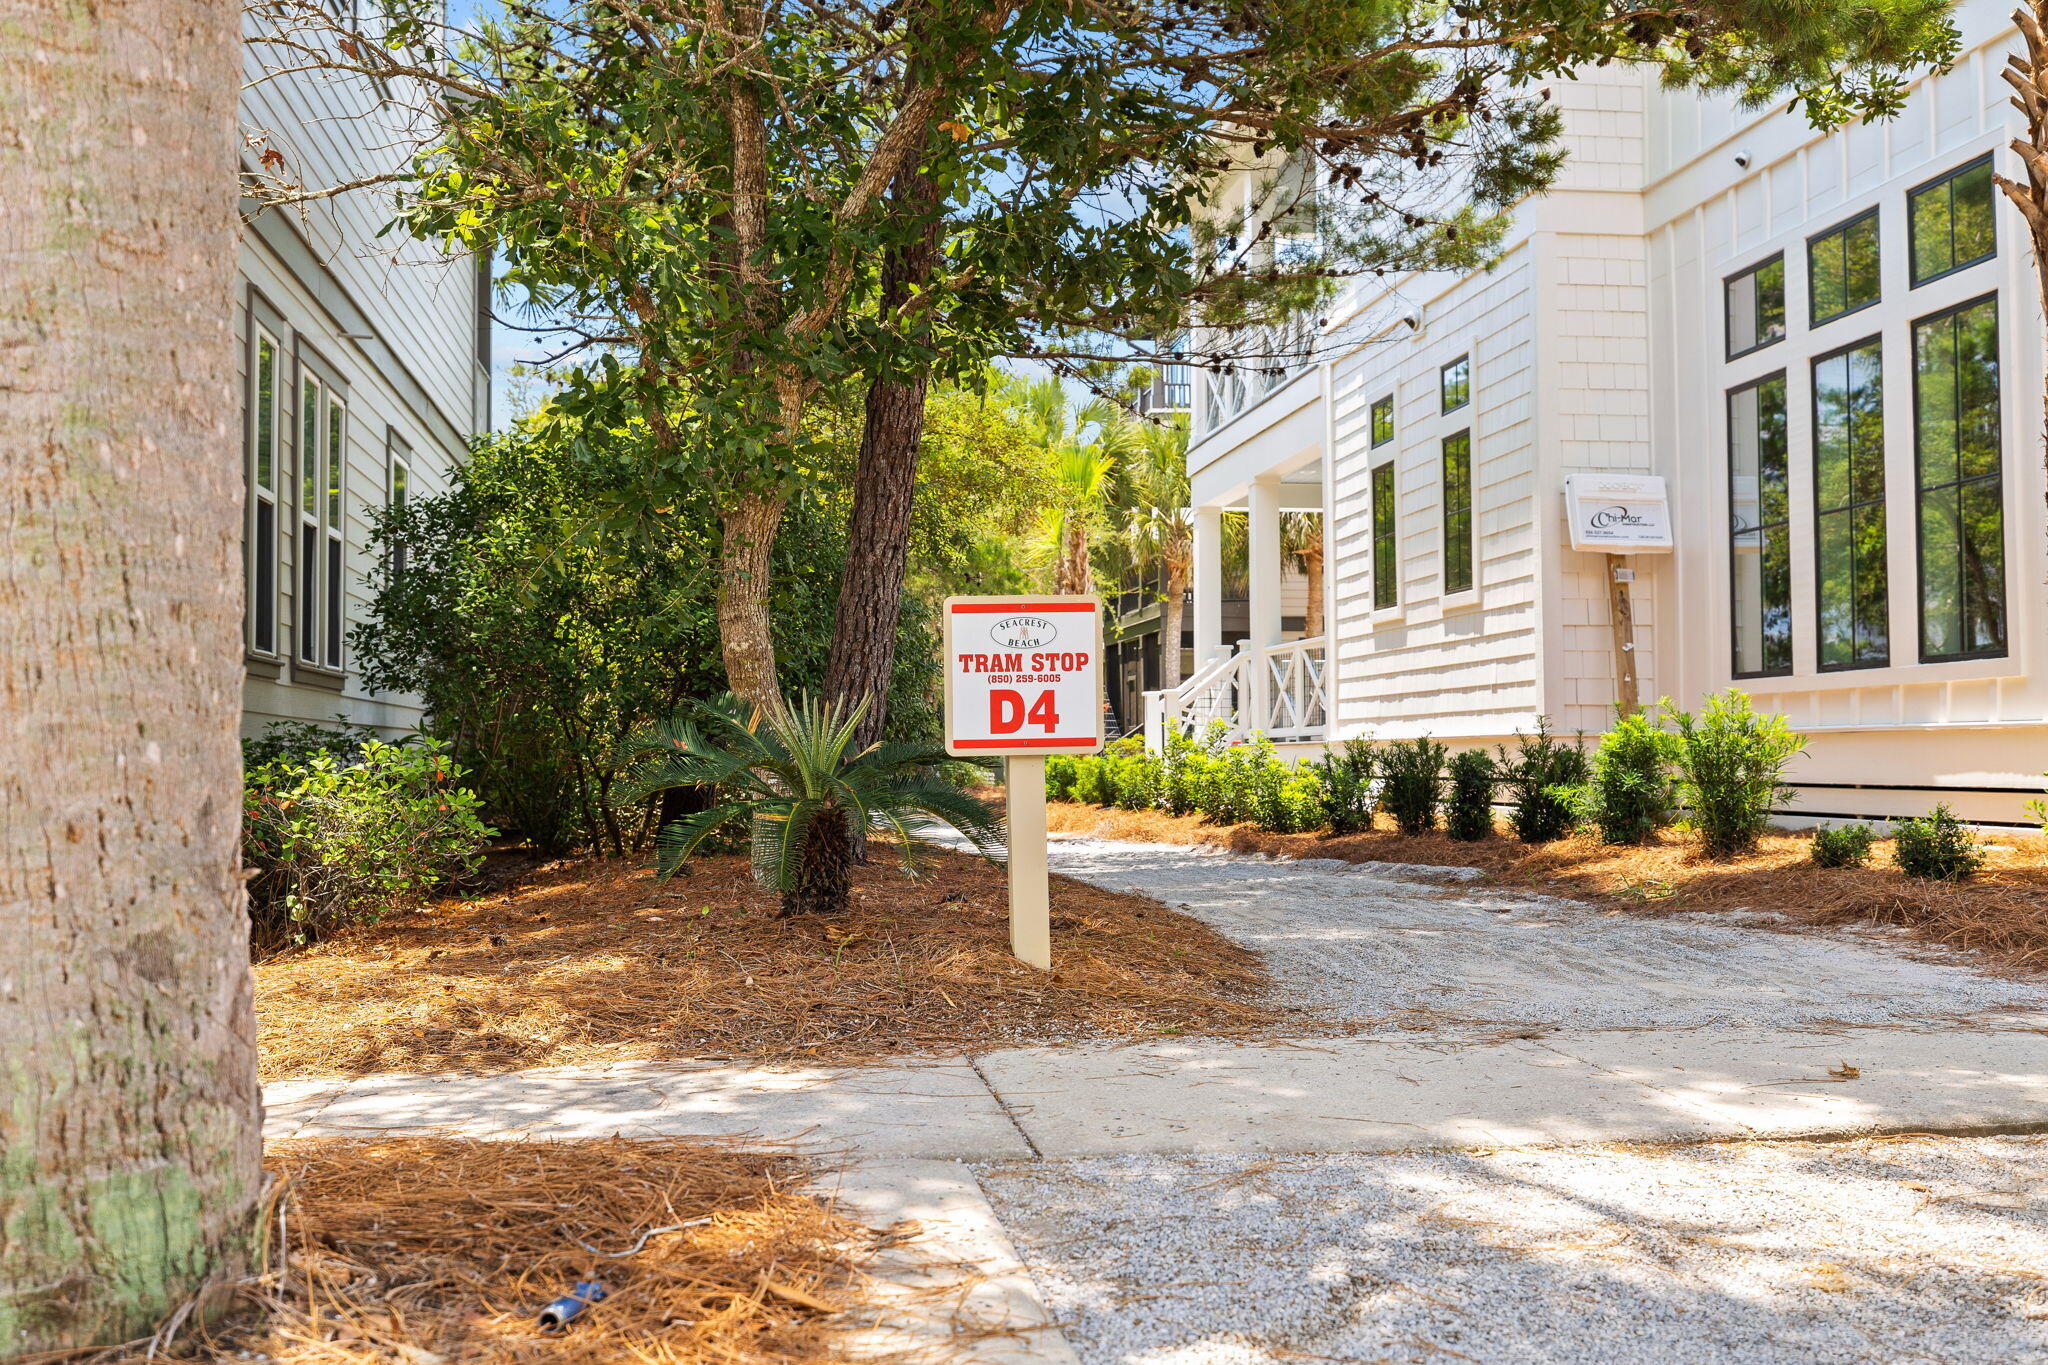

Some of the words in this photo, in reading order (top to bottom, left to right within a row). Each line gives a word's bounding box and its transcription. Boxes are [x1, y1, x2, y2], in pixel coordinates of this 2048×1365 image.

[999, 619, 1047, 630] SEACREST
[1008, 638, 1040, 647] BEACH
[959, 653, 1023, 673] TRAM
[1031, 652, 1089, 672] STOP
[987, 674, 1013, 685] (850)
[1016, 674, 1061, 683] 259-6005
[990, 689, 1060, 735] D4
